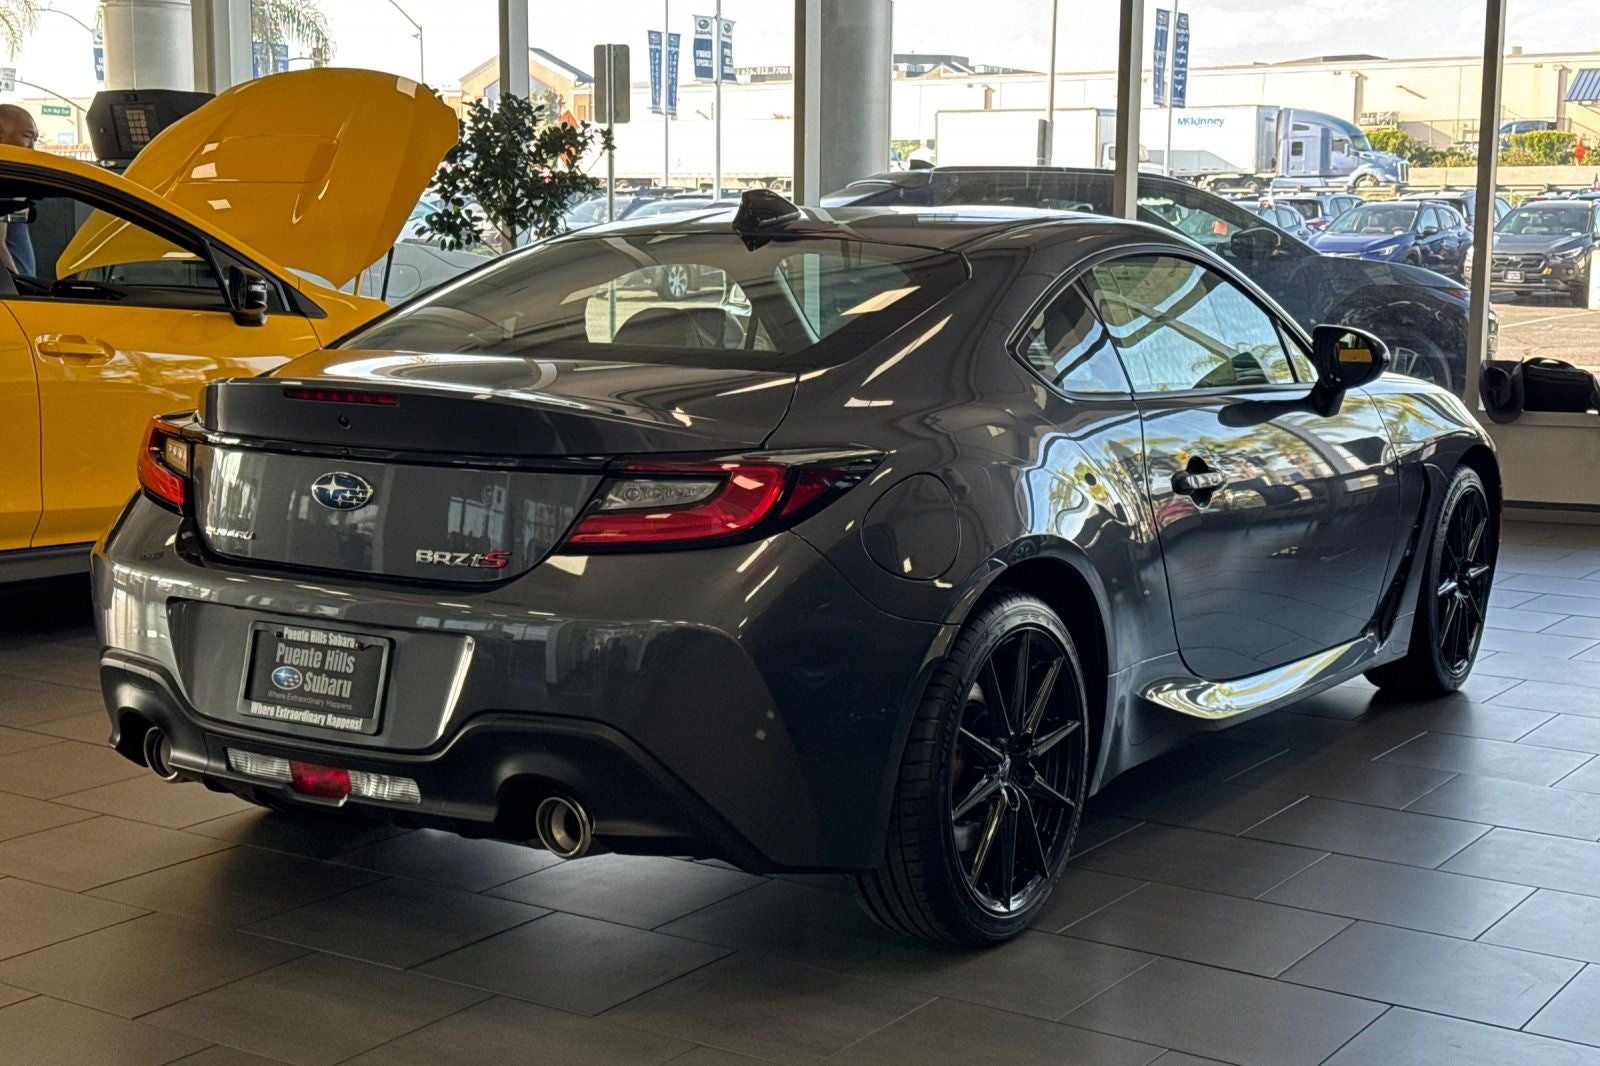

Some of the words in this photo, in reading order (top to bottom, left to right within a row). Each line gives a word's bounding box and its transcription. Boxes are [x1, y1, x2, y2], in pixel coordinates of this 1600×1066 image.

[416, 549, 470, 566] BRZ
[283, 626, 310, 642] Puente
[310, 630, 328, 645] Hills
[328, 632, 356, 647] Subaru
[275, 642, 322, 669] Puente
[324, 649, 356, 674] Hills
[303, 671, 352, 698] Subaru
[267, 689, 287, 700] Where
[287, 693, 325, 706] Extraordinary
[326, 700, 352, 710] Happens
[250, 701, 275, 717] Where
[275, 705, 326, 726] Extraordinary
[326, 713, 363, 731] Happens!
